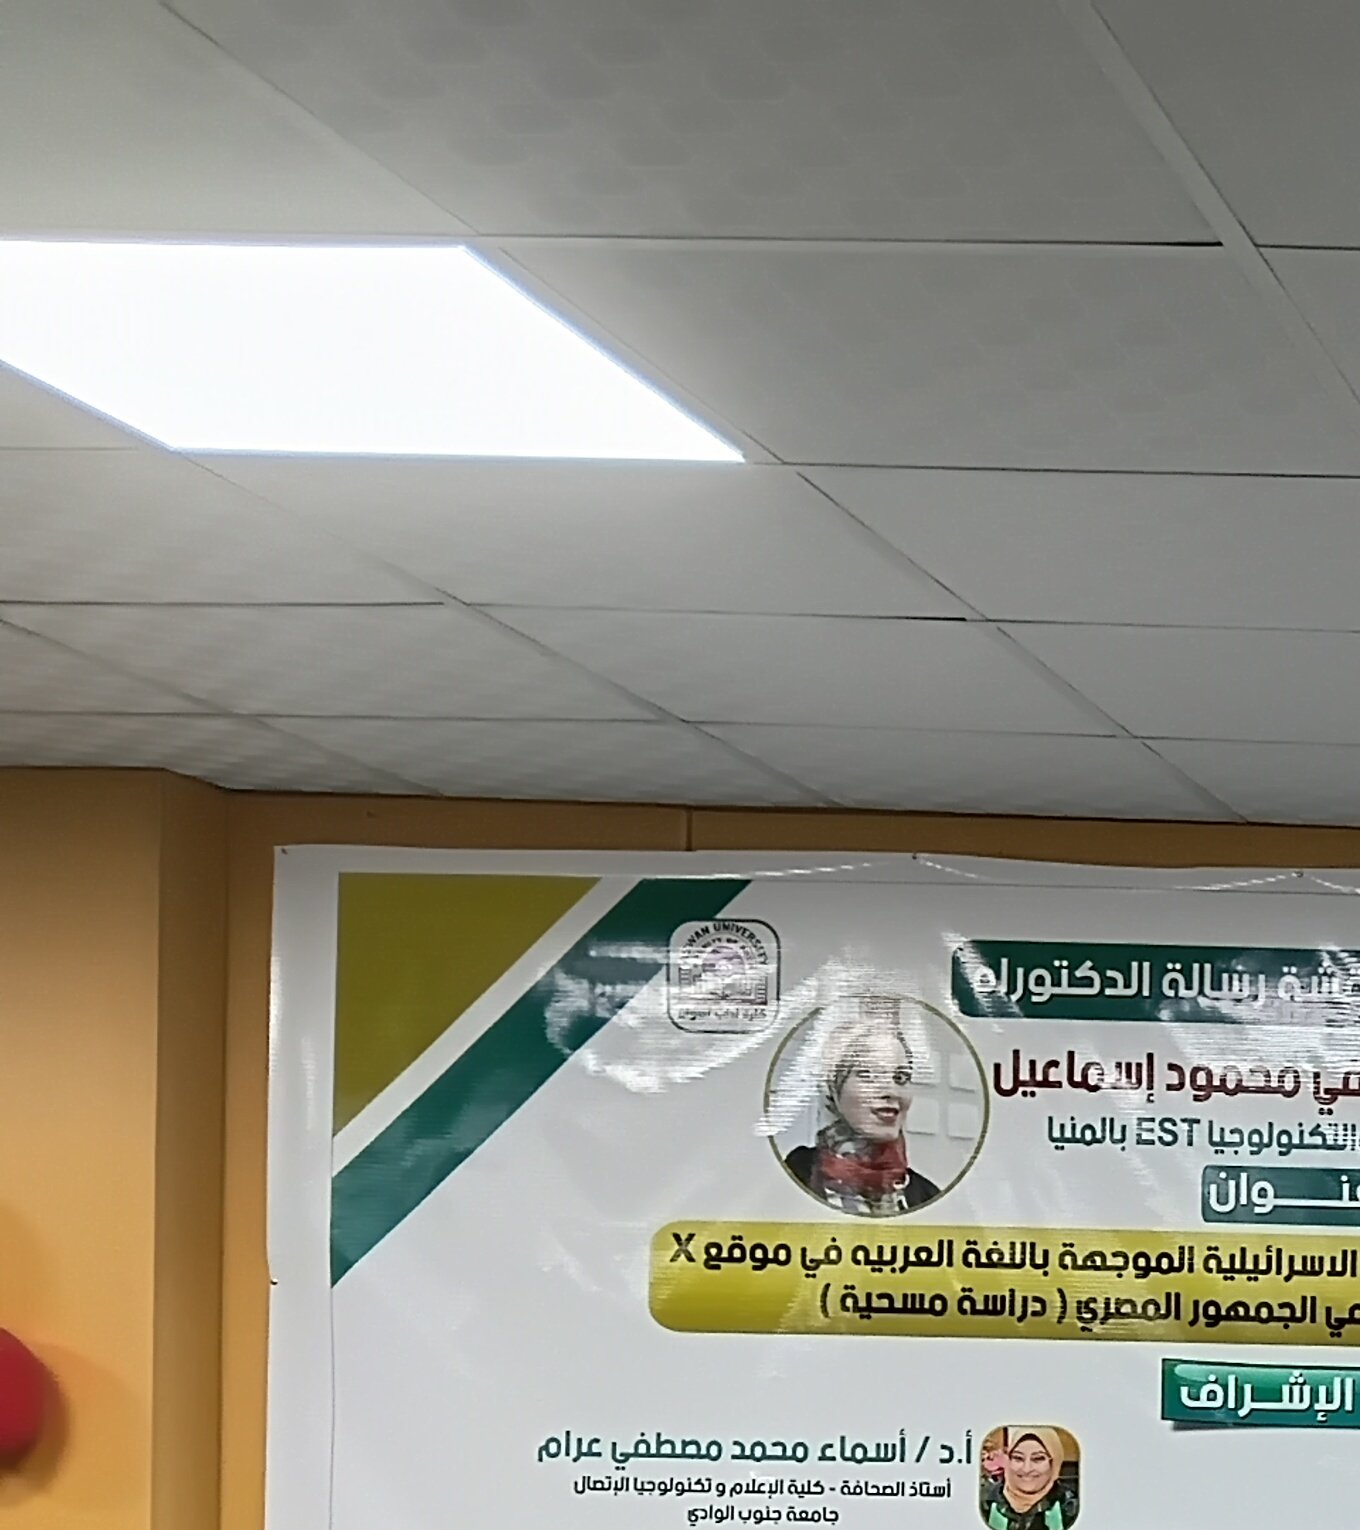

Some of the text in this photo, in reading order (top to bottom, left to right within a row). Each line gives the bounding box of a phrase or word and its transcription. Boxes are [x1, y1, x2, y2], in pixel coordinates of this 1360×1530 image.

[1161, 961, 1265, 1004] رسالة
[991, 1048, 1156, 1104] إسماعيل
[1165, 1063, 1301, 1103] محمود
[1047, 1115, 1127, 1152] بالمنيا
[1135, 1117, 1201, 1147] EST
[669, 1232, 696, 1263] X
[703, 1234, 792, 1272] موقع
[800, 1236, 843, 1279] في
[851, 1239, 954, 1274] العربيه
[961, 1239, 1050, 1277] باللغة
[1058, 1242, 1195, 1279] الموجهة
[1202, 1244, 1358, 1283] الاسرائيلية
[838, 1282, 949, 1321] مسحية
[955, 1286, 1048, 1321] دراسة
[1187, 1293, 1318, 1332] الجمهور
[537, 1428, 973, 1471] أ.د أسماء محمد مصطفي عرام
[573, 1475, 951, 1500] أستاذ الصحافة كلية الإعلام تكنولوجيا الإتصال
[687, 1504, 839, 1527] جامعة جنوب الوادي
